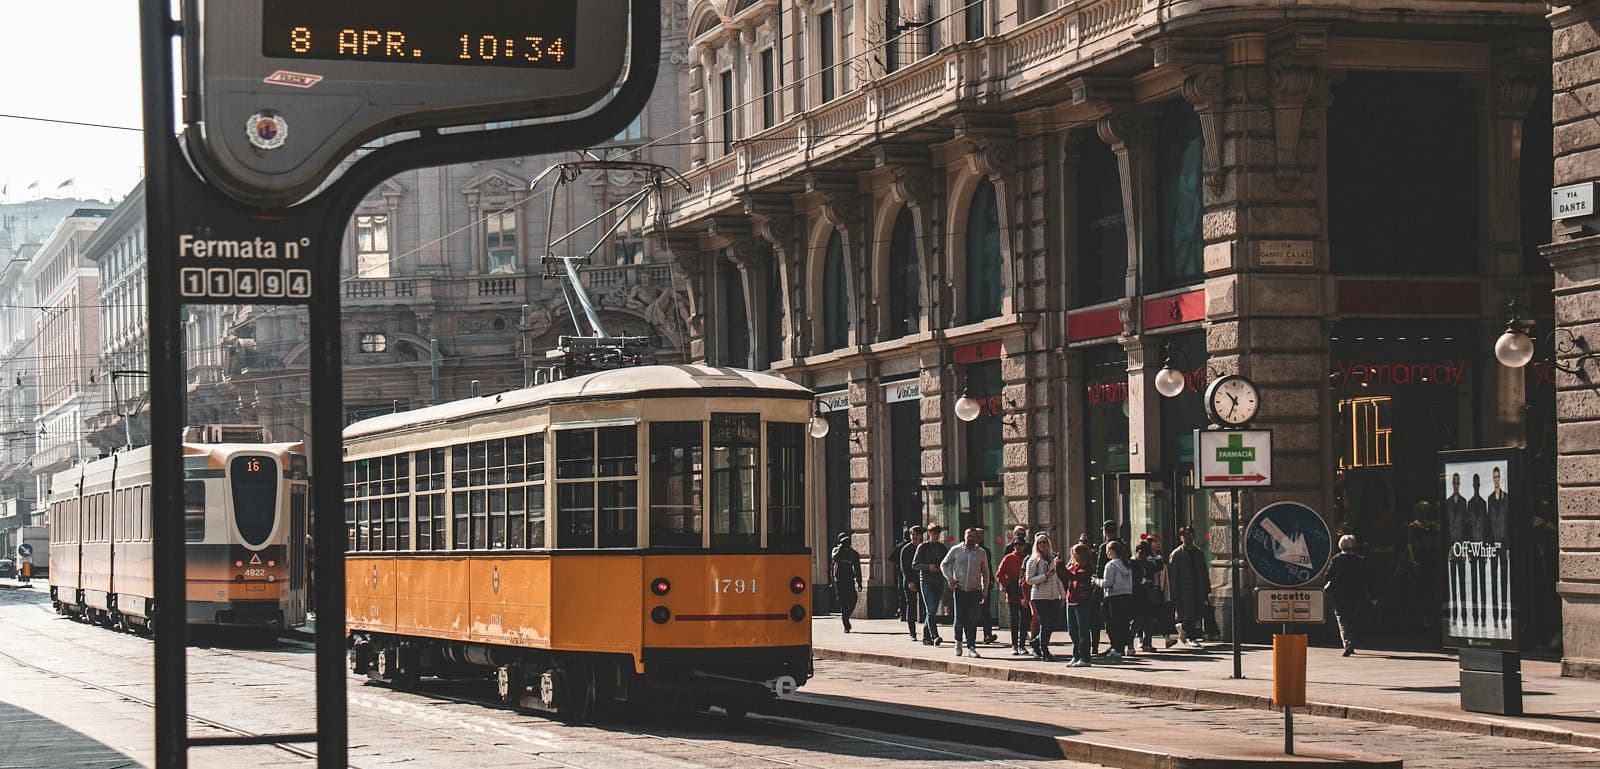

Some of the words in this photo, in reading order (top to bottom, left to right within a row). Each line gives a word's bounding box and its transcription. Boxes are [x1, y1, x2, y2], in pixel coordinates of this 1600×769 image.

[291, 26, 311, 53] 8
[339, 29, 422, 57] APR.
[459, 34, 565, 62] 10:34
[1560, 201, 1586, 213] DANTE
[179, 234, 277, 259] Fermata
[185, 272, 308, 295] 11494
[902, 384, 920, 398] UniCredit
[1218, 450, 1253, 458] FARMACIA
[247, 461, 260, 472] 16
[244, 569, 265, 577] 4922
[714, 578, 758, 594] 1794
[1271, 591, 1311, 601] eccetto
